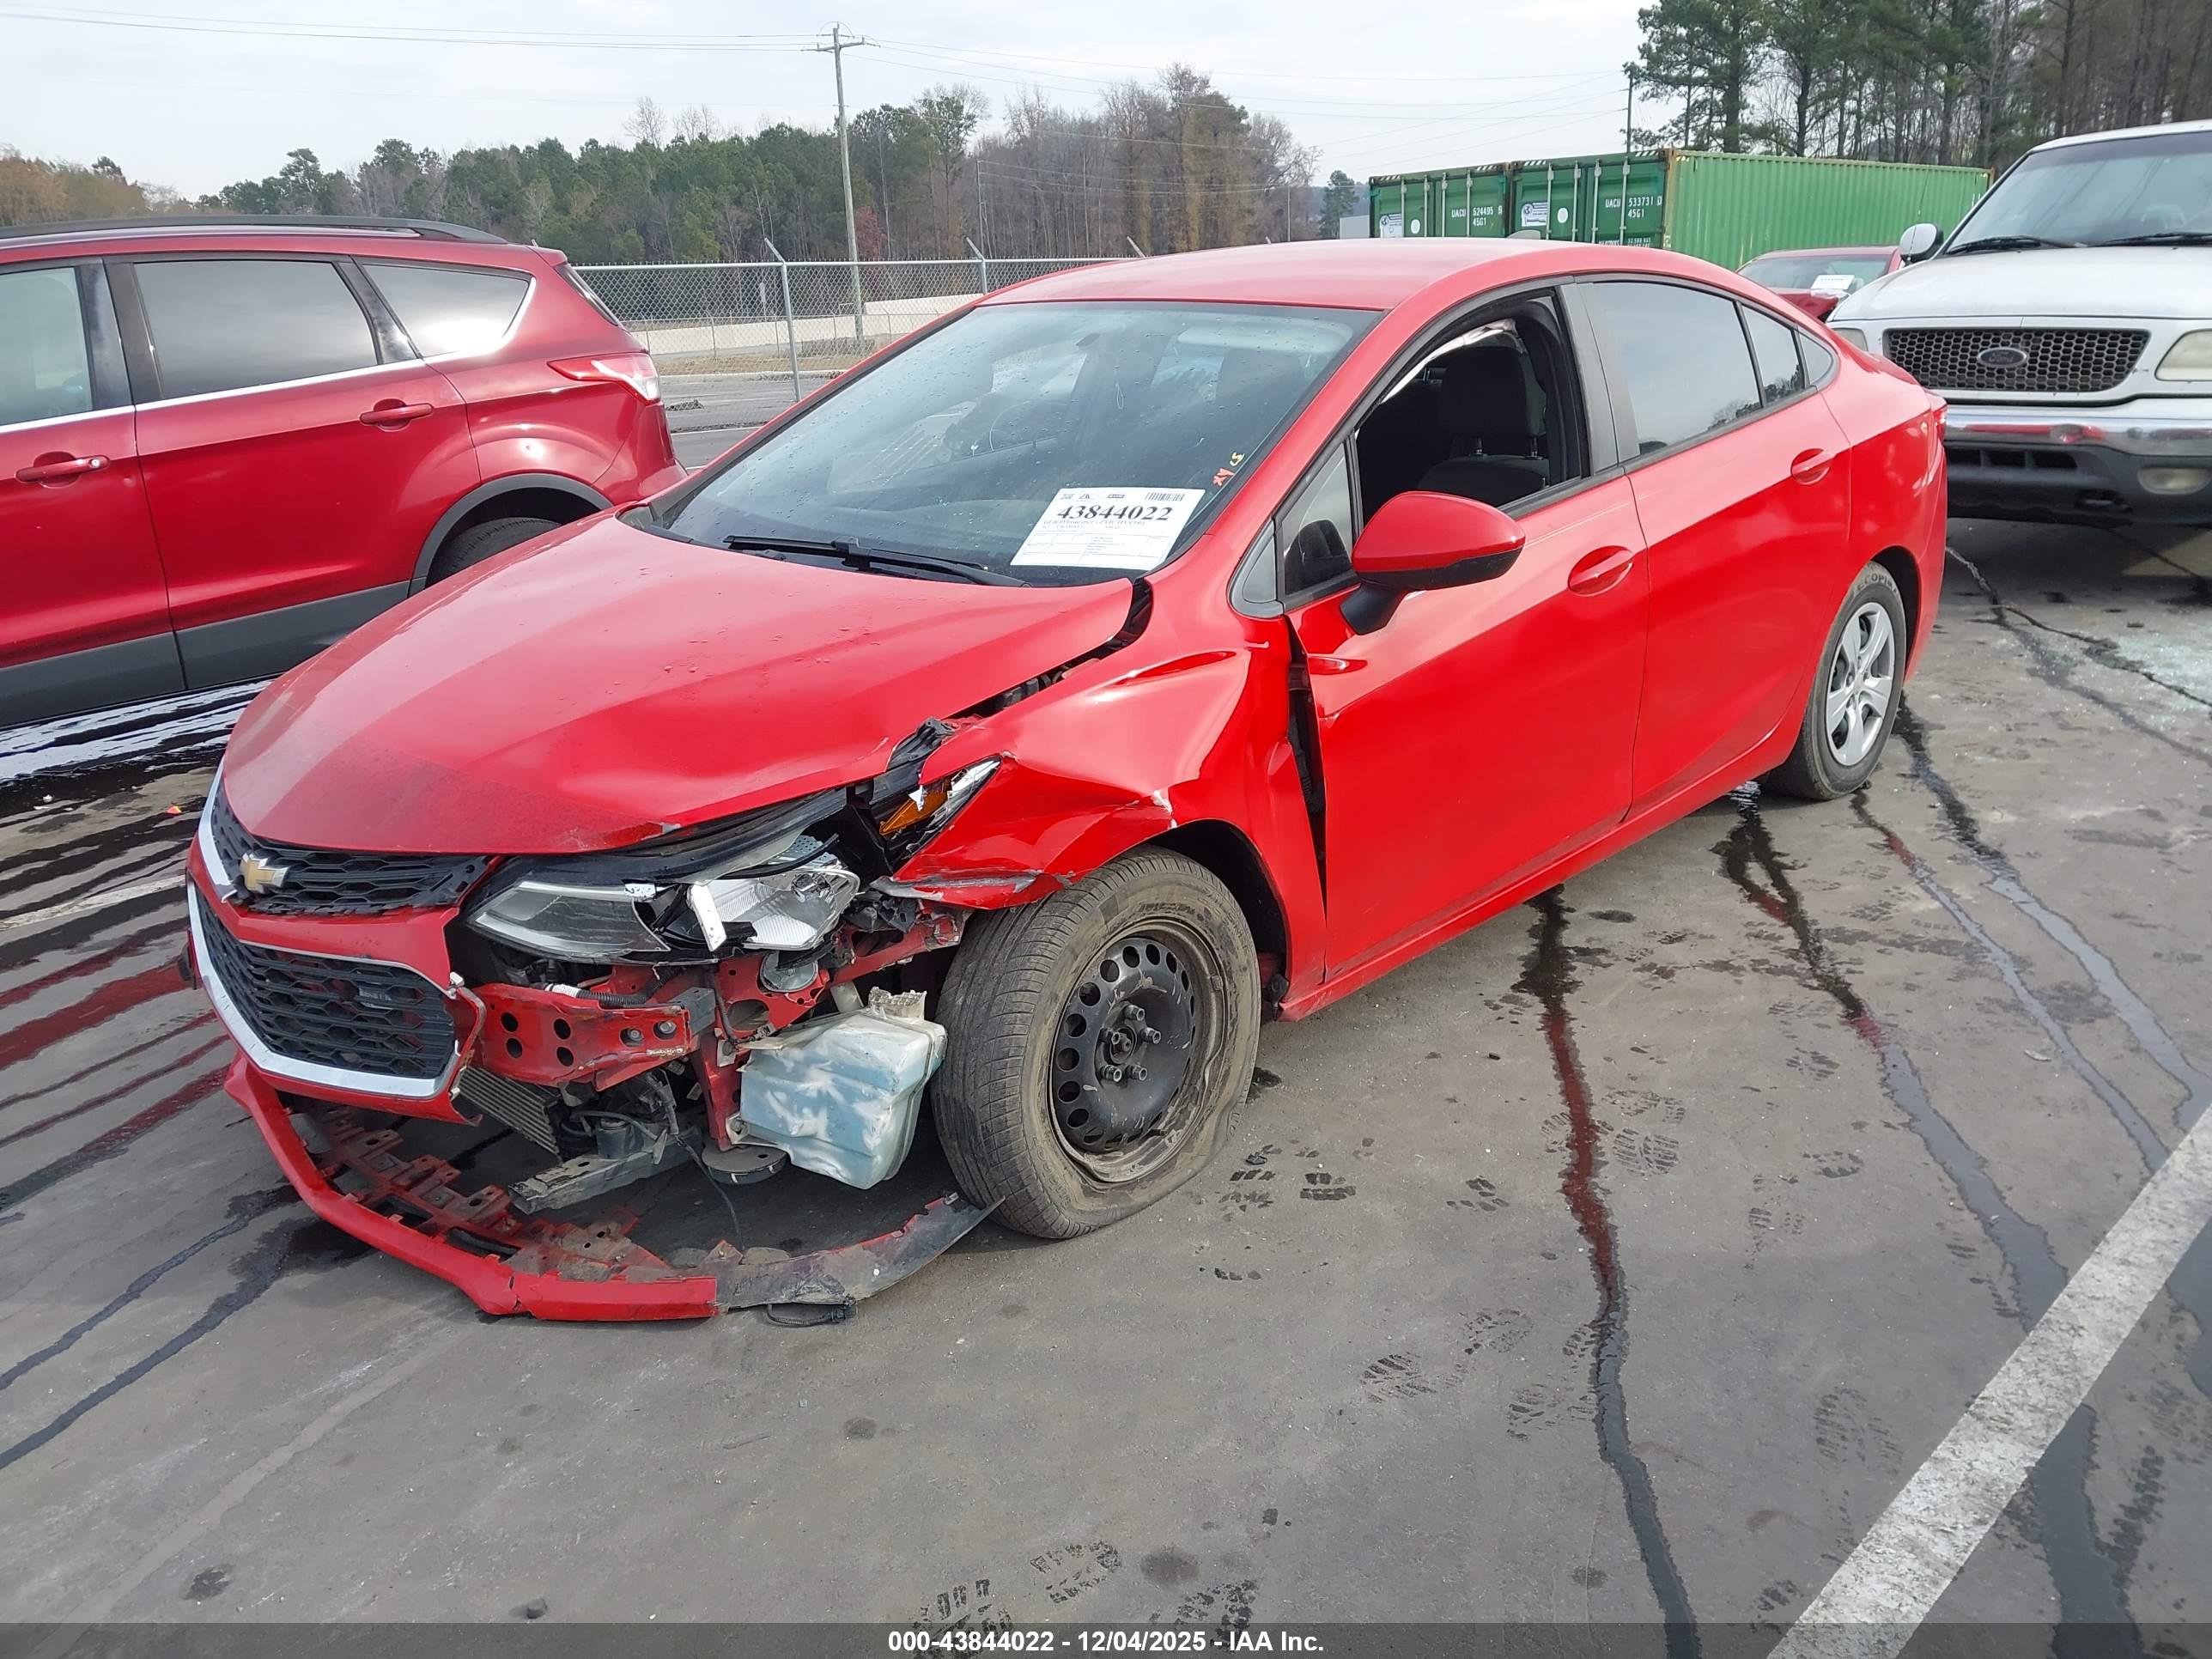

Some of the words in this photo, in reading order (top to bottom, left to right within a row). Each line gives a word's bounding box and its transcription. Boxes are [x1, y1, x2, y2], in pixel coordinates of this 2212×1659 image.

[1605, 198, 1621, 208] UACU
[1628, 197, 1654, 207] 533731
[1451, 209, 1467, 218] UACU
[1057, 504, 1174, 521] 43844022
